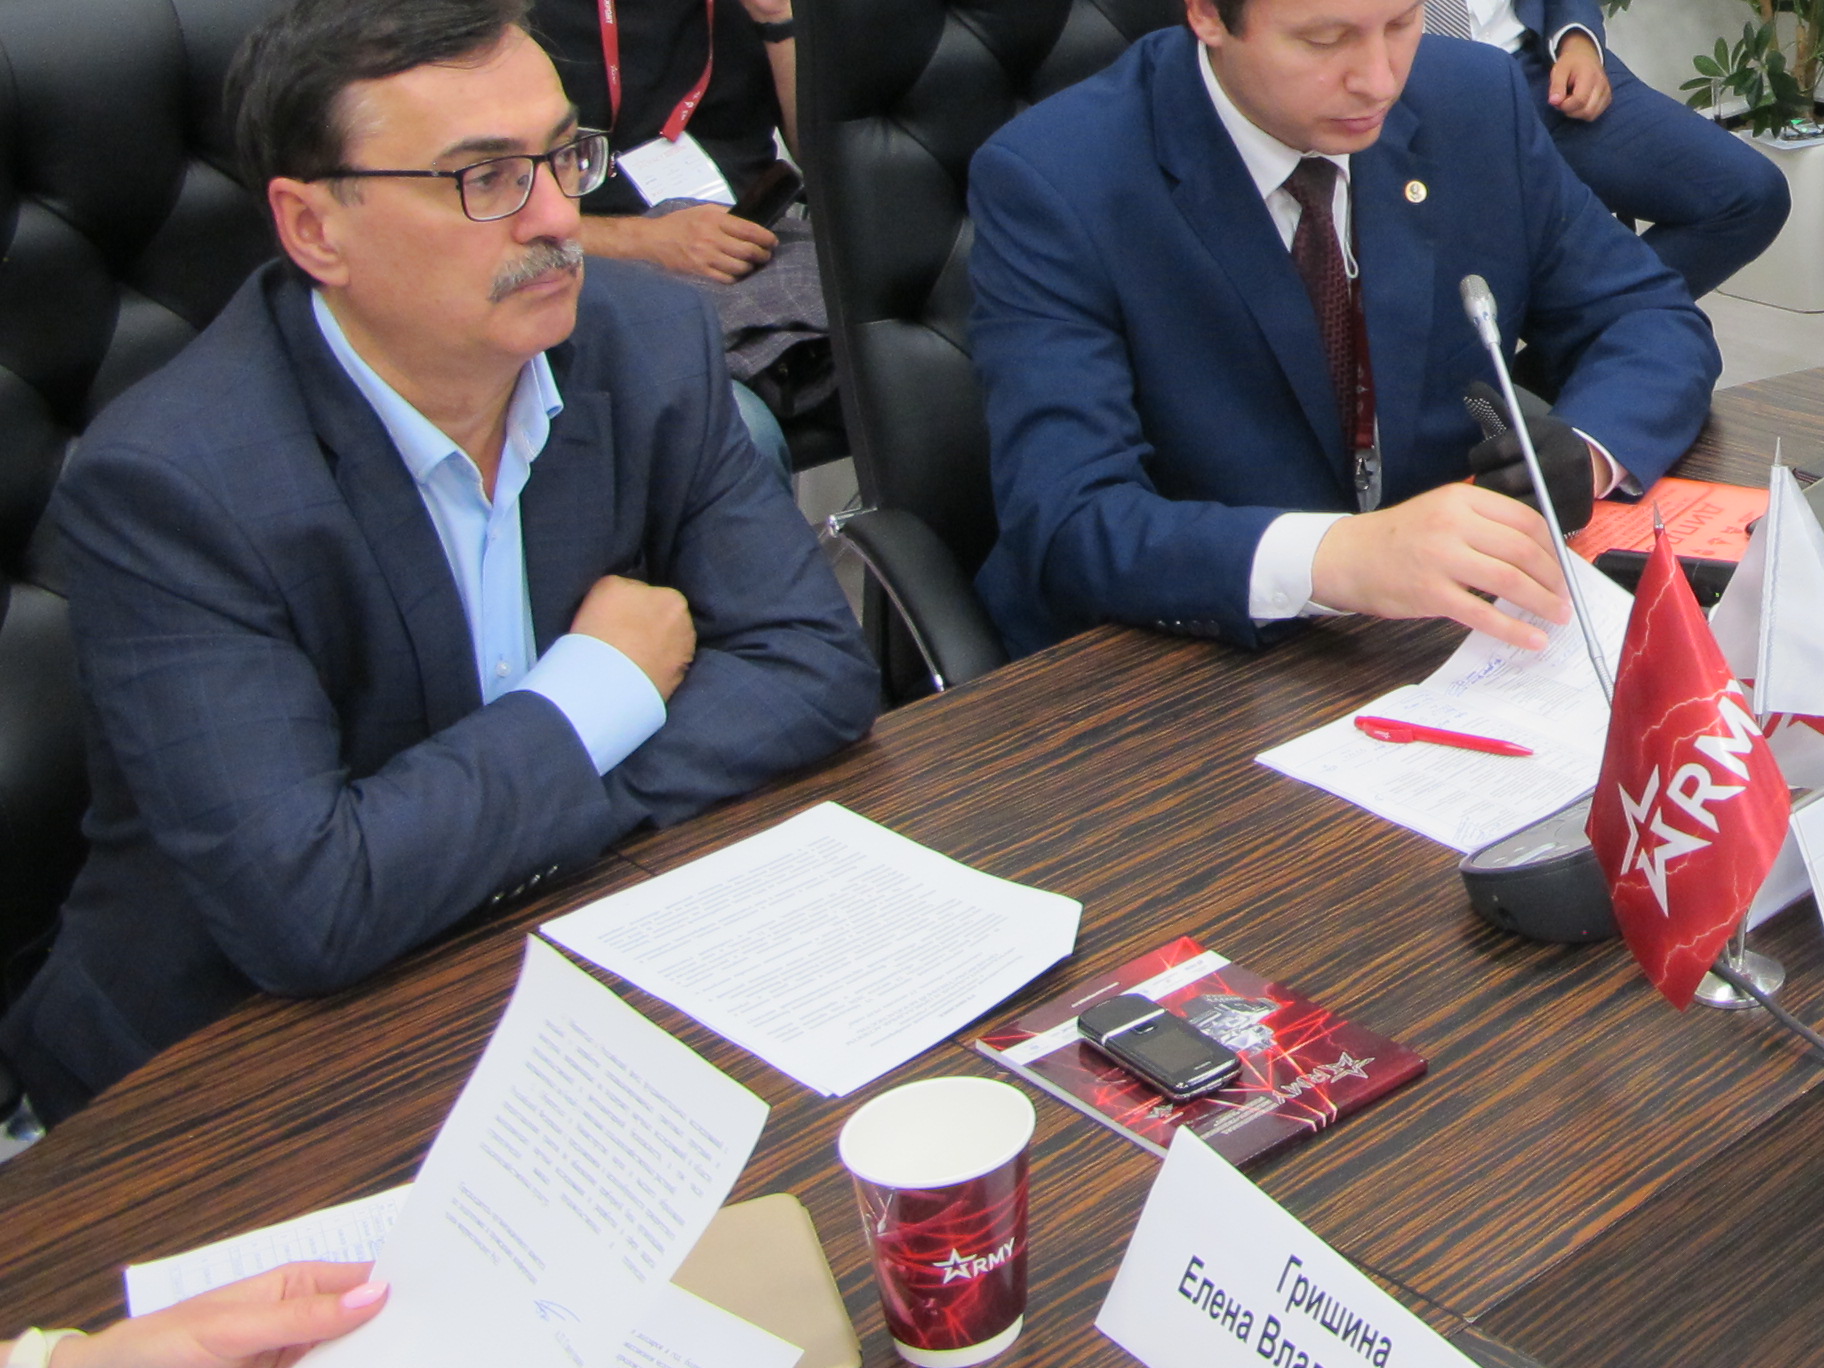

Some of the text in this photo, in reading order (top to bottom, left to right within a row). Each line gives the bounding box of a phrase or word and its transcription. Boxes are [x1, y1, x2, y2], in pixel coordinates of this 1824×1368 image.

[1177, 1254, 1326, 1368] Елена Вла
[1276, 1253, 1393, 1368] Гришина
